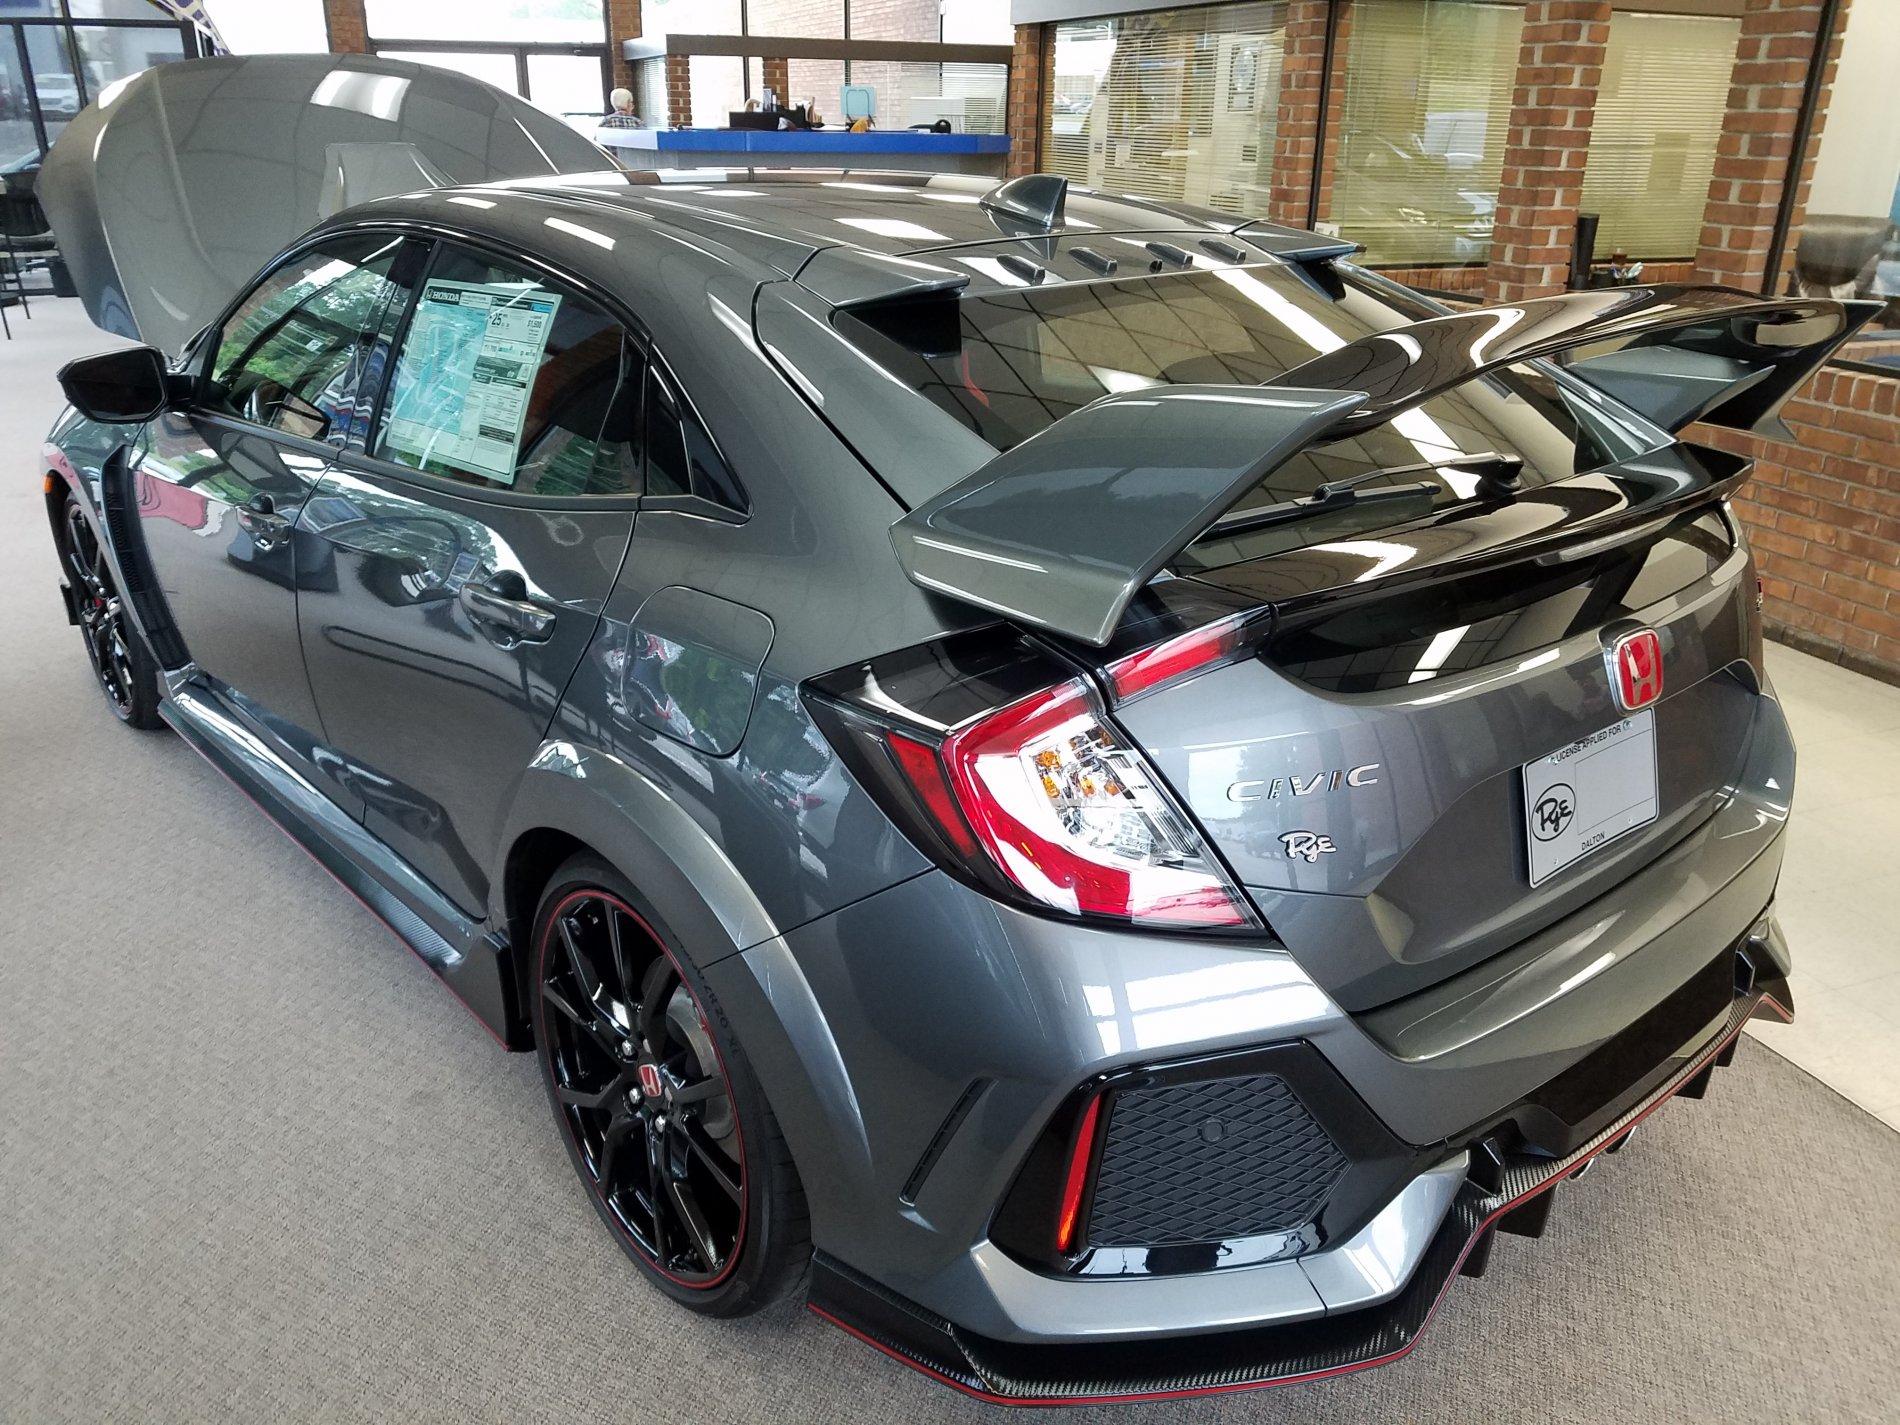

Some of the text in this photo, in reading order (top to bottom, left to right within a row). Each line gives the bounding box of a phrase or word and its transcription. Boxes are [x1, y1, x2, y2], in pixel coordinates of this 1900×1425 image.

[432, 291, 460, 302] HONDA
[1556, 724, 1622, 762] LICENSE APPLIED FOR
[1226, 763, 1380, 802] CIVIC
[1581, 832, 1605, 851] DALTON
